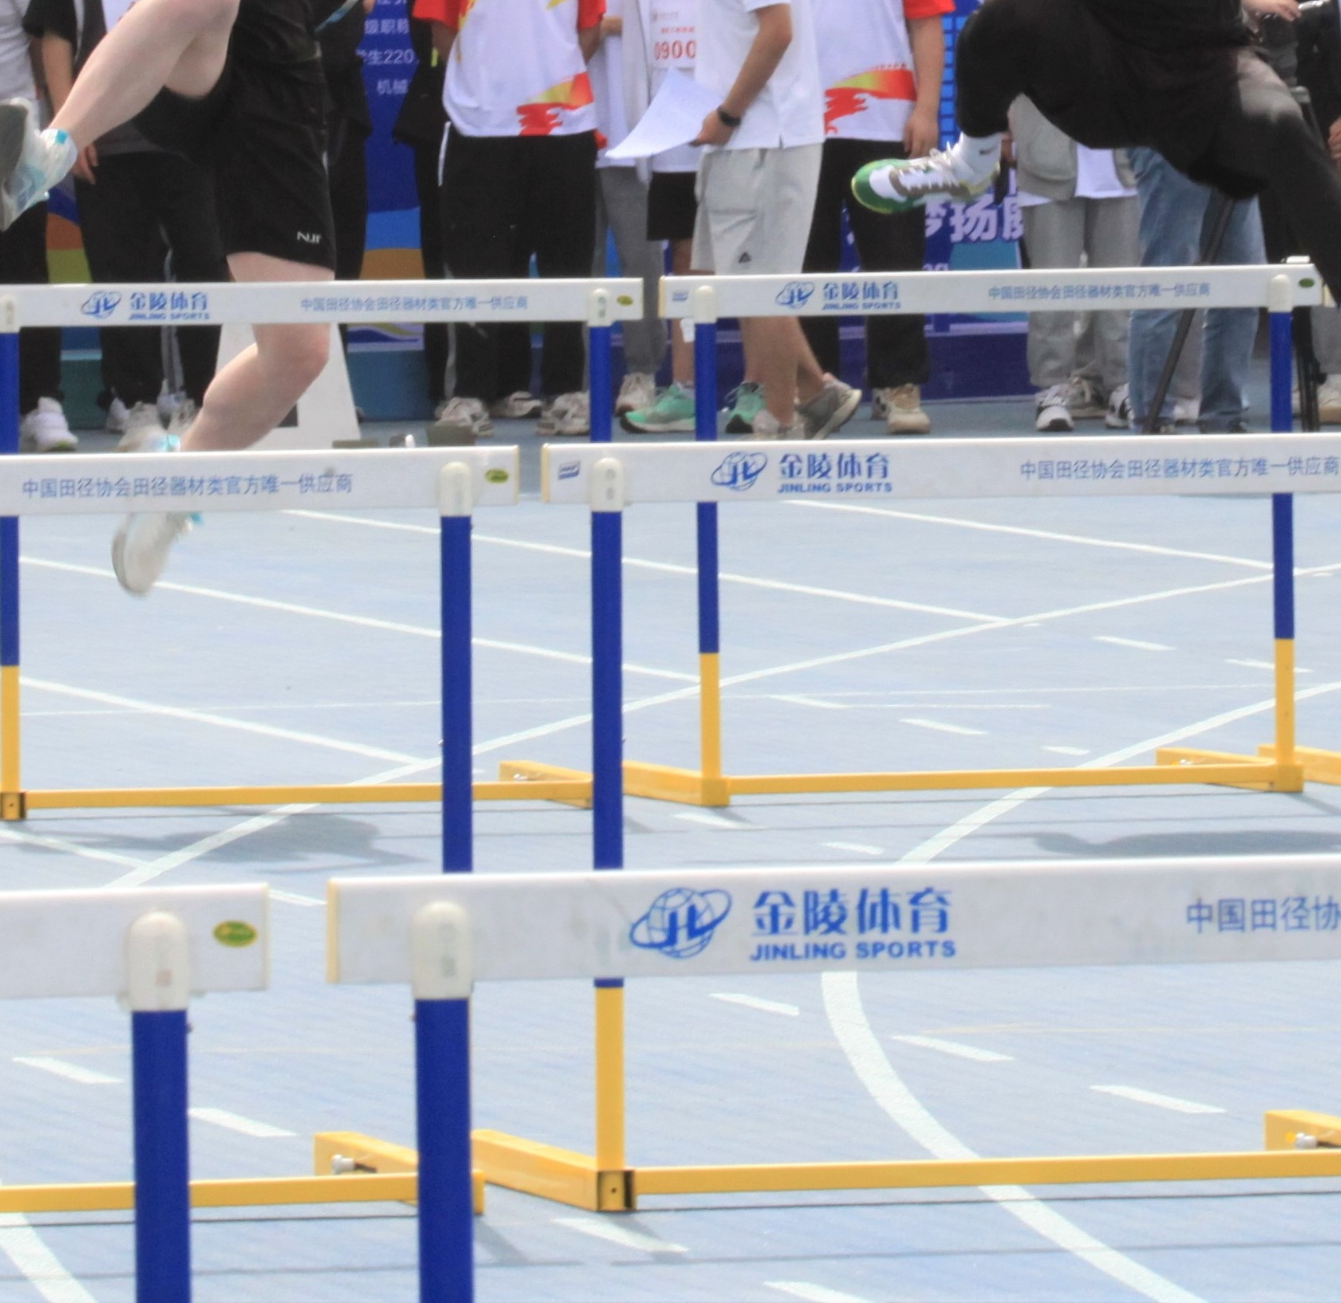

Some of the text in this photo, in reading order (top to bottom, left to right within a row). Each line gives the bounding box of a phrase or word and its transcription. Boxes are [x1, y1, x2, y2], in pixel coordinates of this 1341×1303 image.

[130, 292, 208, 312] 金陵体育
[823, 282, 899, 303] 金陵体育
[780, 453, 889, 481] 金陵体育
[1020, 456, 1339, 481] 中国田径协会田径器材类官方唯一供应商
[22, 473, 352, 499] 中国田径协会田径器材类官方唯一供应商
[778, 482, 892, 494] JINLING SPORTS
[754, 888, 949, 937] 金陵体育
[752, 940, 956, 961] JINLING SPORTS
